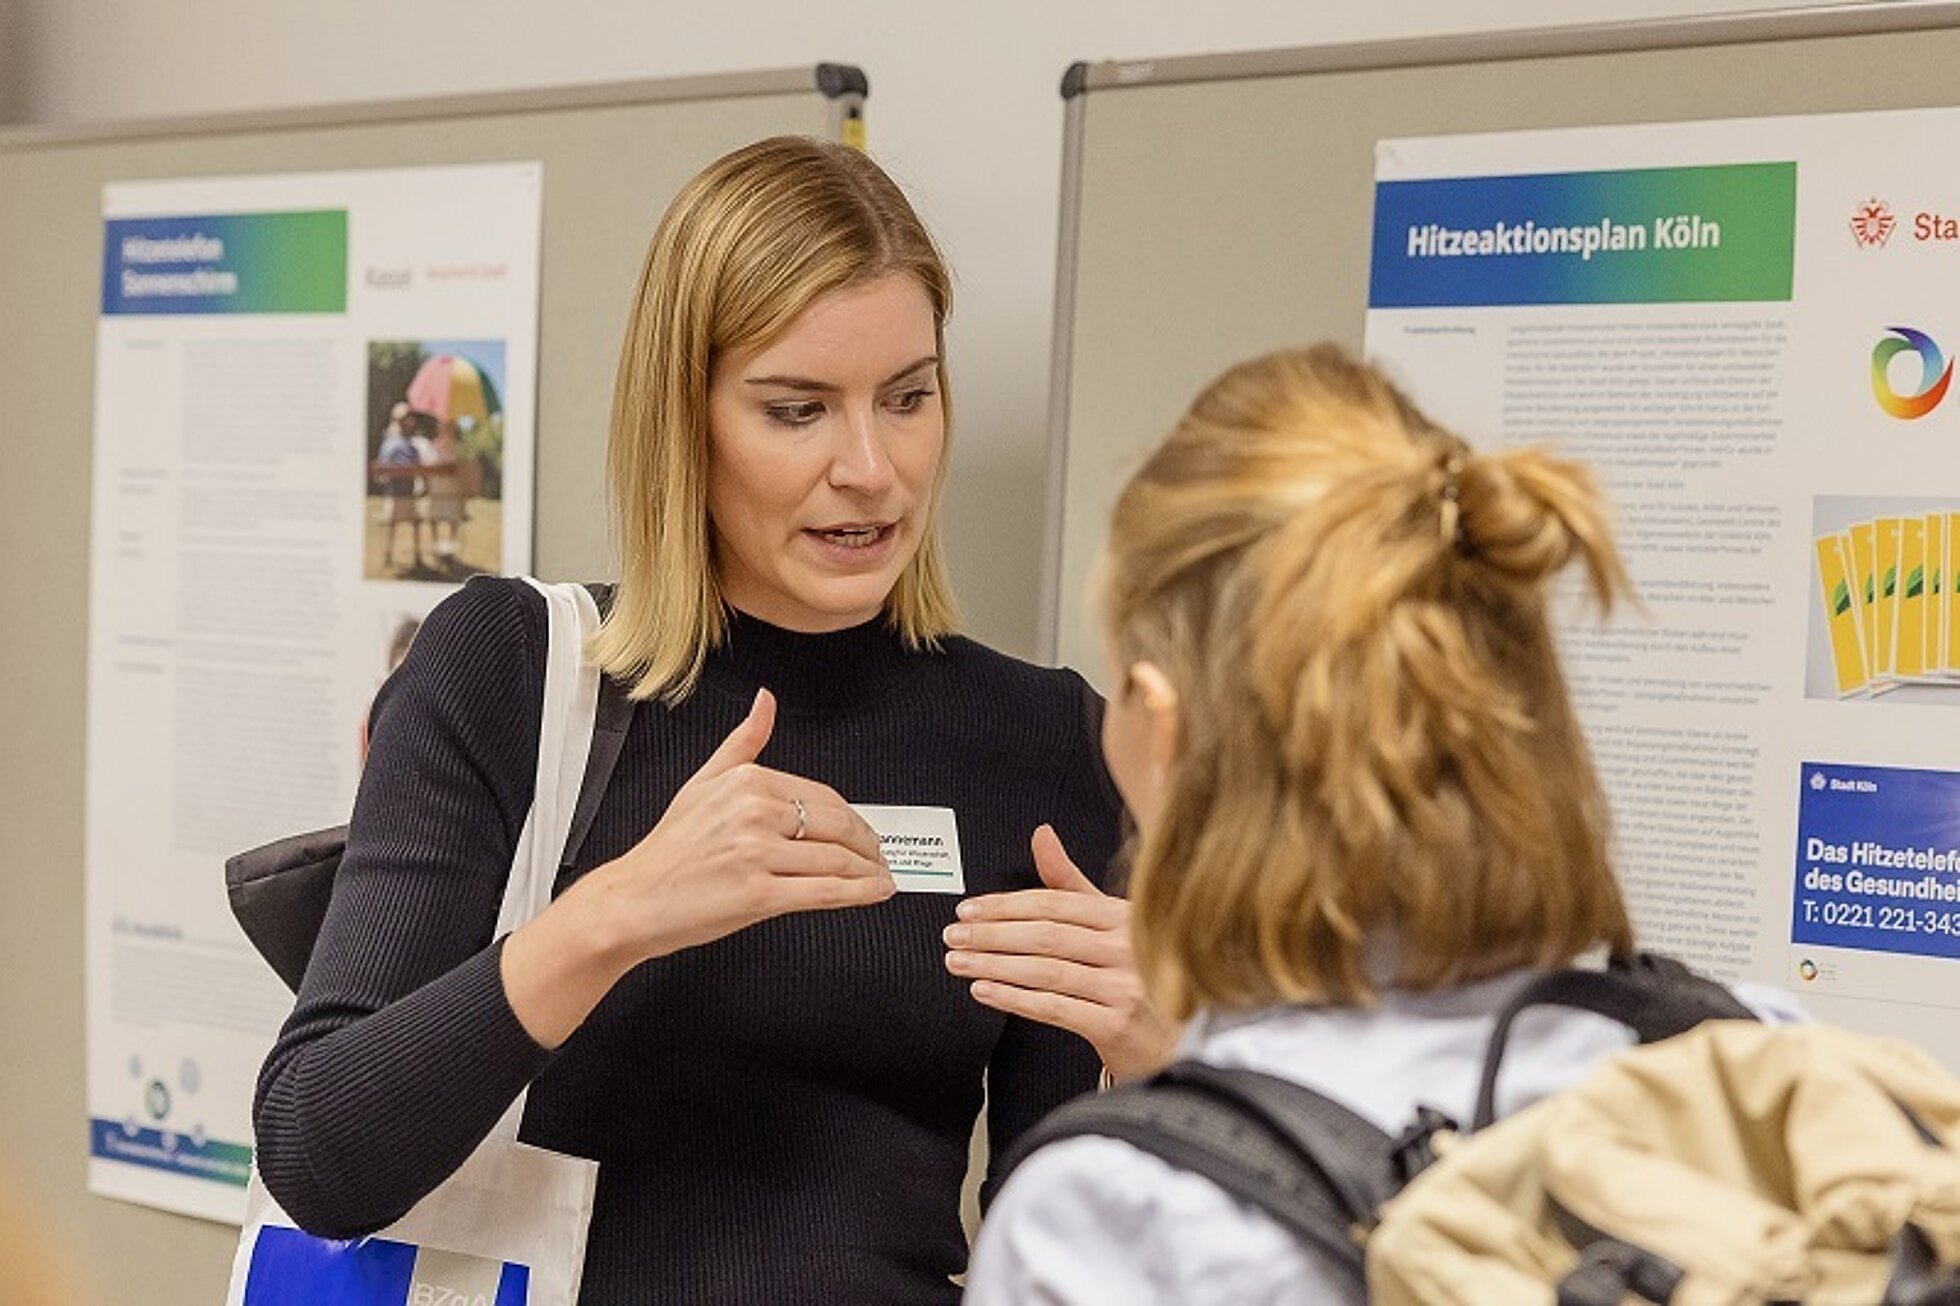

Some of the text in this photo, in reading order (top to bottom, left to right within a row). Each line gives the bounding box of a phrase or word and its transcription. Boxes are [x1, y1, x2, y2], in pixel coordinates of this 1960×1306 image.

[1406, 214, 1721, 261] Hitzeaktionsplan Köln
[1914, 212, 1959, 241] Sta
[1830, 778, 1878, 793] Stadt Köln
[1806, 838, 1848, 863] Das
[1804, 867, 1843, 891] des
[1803, 900, 1960, 937] T: 0221 221-343
